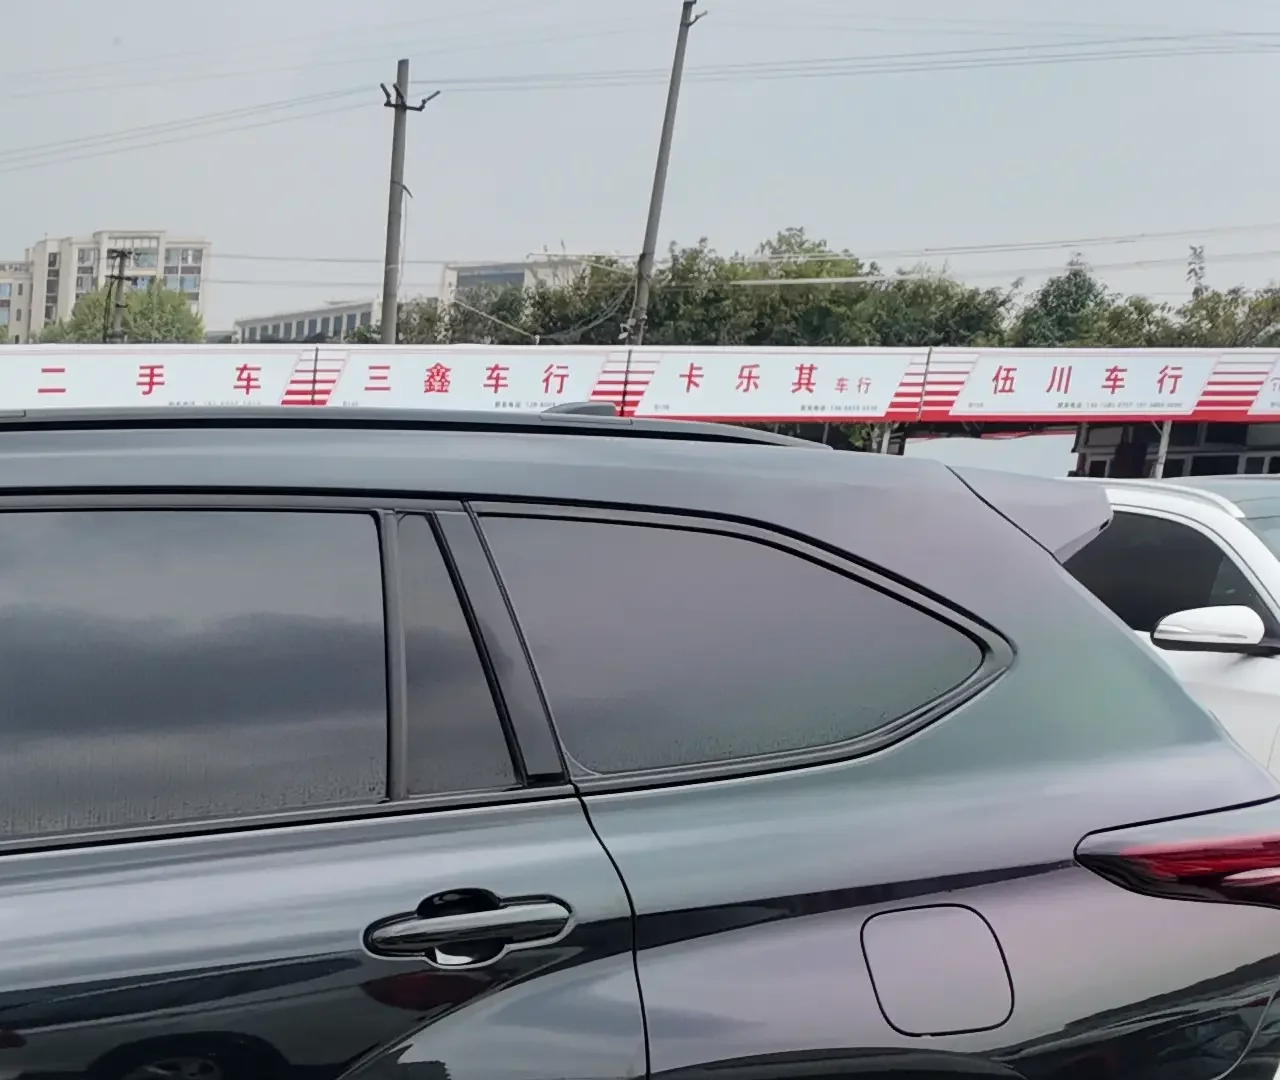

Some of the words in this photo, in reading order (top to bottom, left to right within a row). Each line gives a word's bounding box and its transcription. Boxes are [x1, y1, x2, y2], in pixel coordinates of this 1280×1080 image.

[364, 362, 570, 394] 三鑫车行
[992, 364, 1184, 395] 伍川车行
